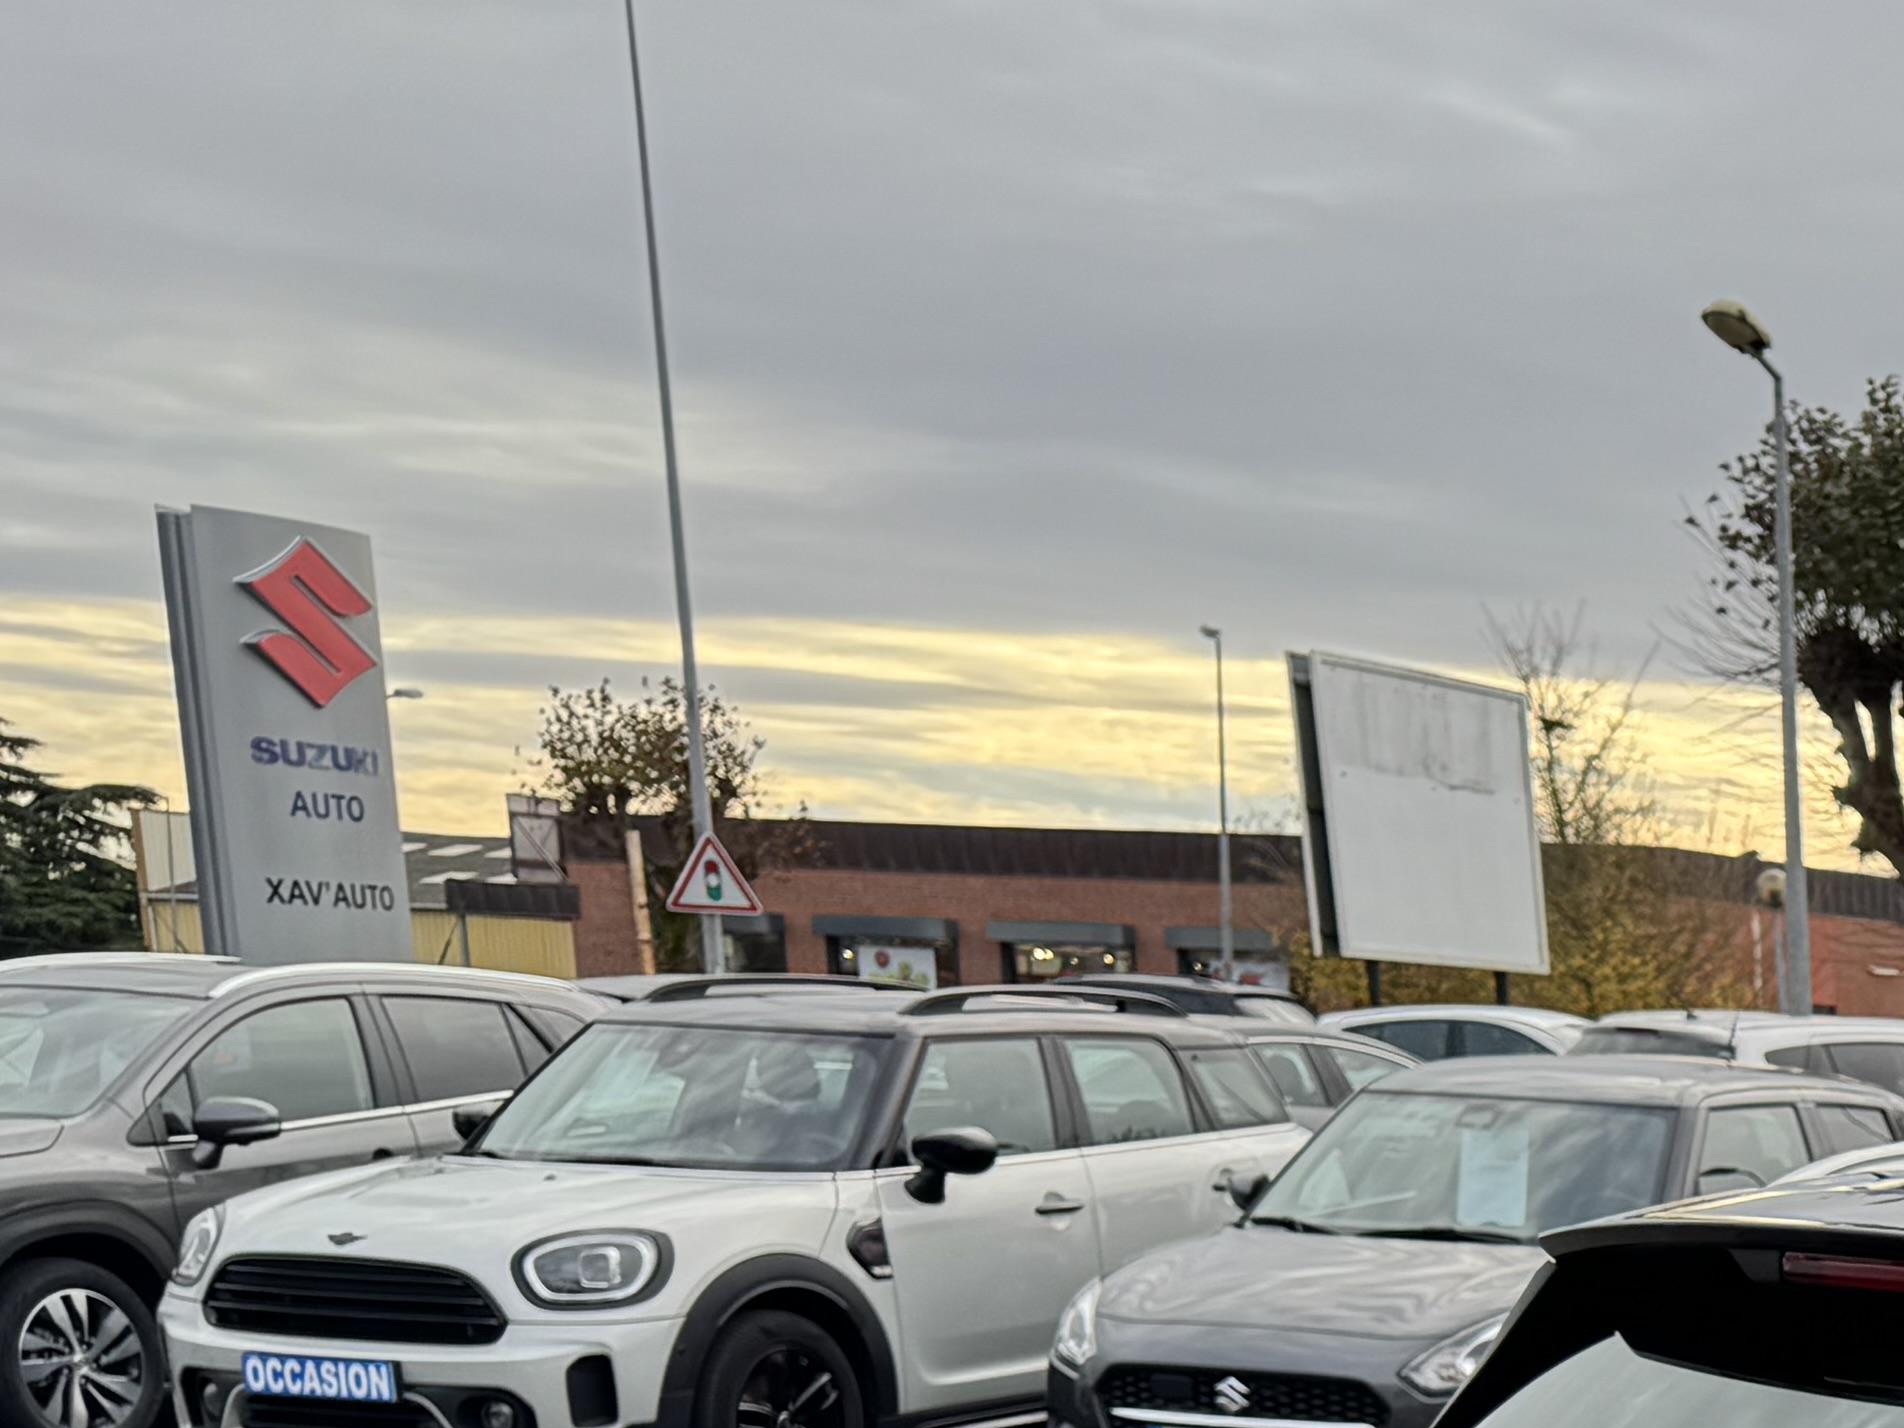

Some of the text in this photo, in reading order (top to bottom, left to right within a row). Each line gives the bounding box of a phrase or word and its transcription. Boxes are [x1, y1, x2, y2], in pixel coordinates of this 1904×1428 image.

[250, 735, 379, 776] SUZUKI
[290, 790, 365, 823] AUTO
[265, 877, 395, 911] XAV'AUTO
[245, 1355, 391, 1401] OCCASION
